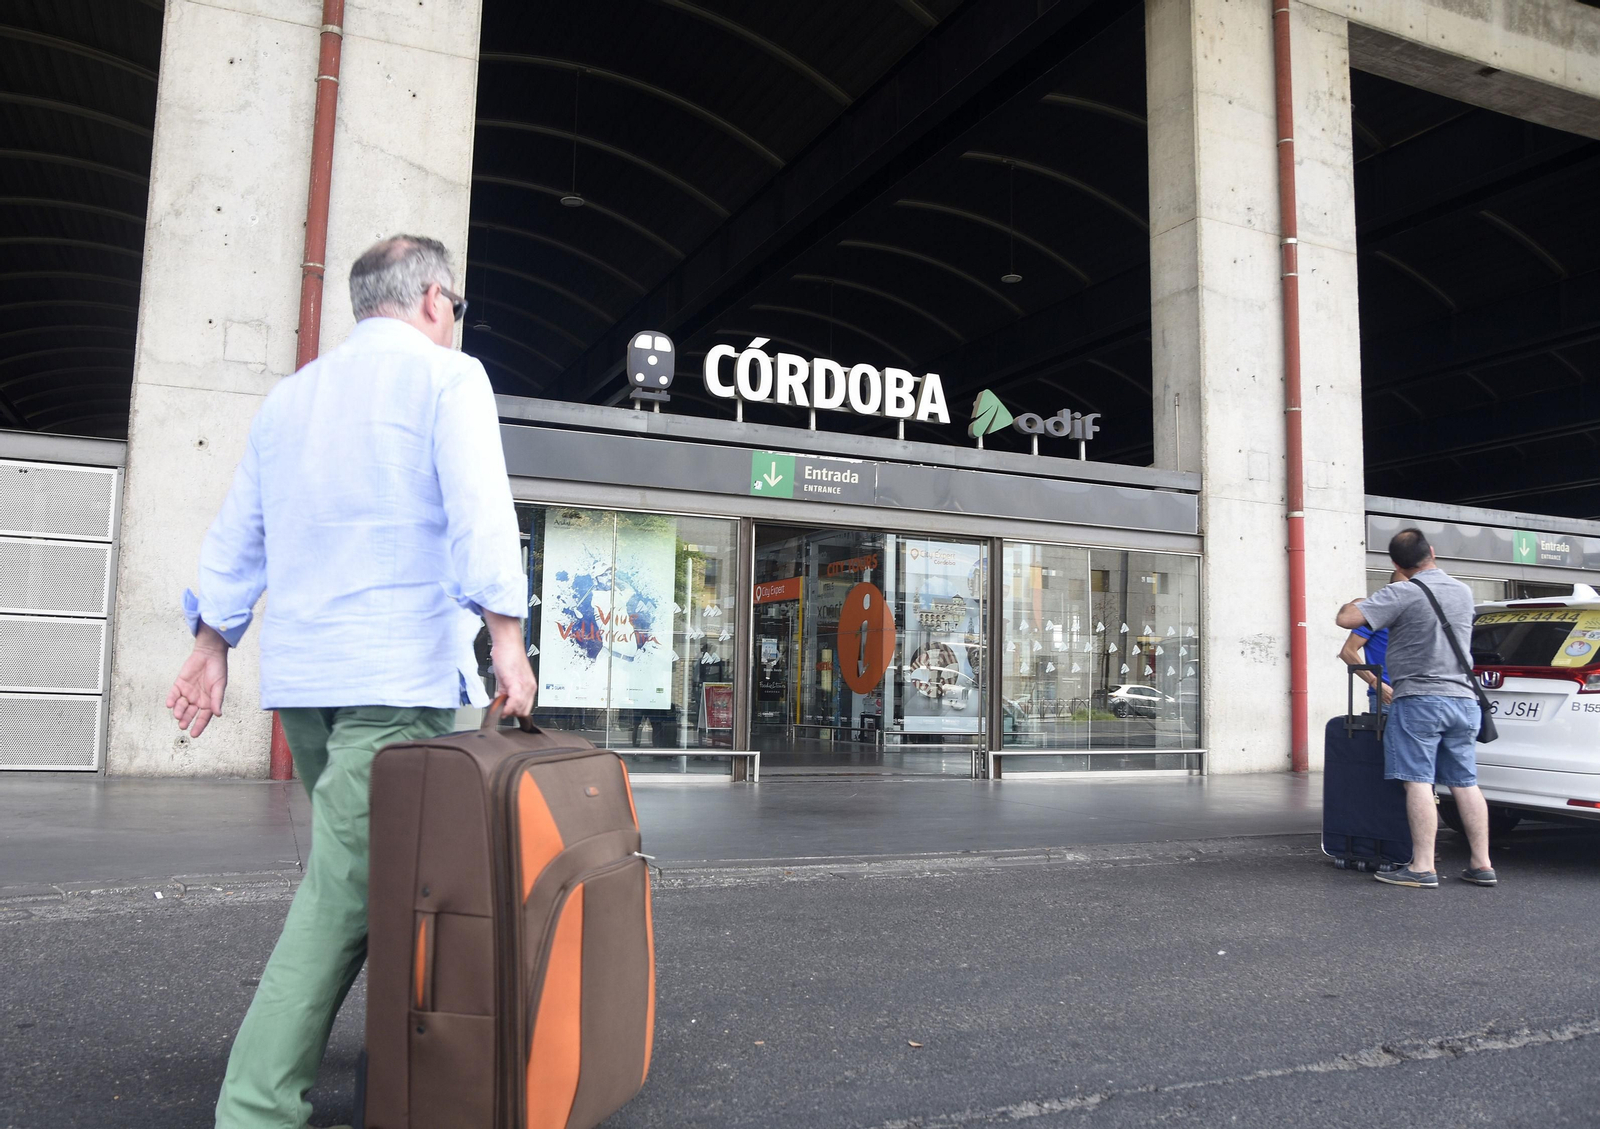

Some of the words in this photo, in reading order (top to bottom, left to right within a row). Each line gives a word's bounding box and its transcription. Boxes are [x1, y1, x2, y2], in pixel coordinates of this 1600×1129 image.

[703, 337, 951, 424] CÓRDOBA
[1012, 408, 1101, 440] adif
[804, 465, 859, 484] Entrada
[803, 484, 841, 495] ENTRANCE
[1541, 540, 1570, 553] Entrada
[920, 550, 933, 559] City
[1541, 553, 1562, 561] ENTRANCE
[827, 561, 845, 577] CITY
[846, 554, 878, 573] TOURS
[761, 586, 770, 597] City
[771, 585, 785, 595] Expert
[1478, 615, 1506, 625] 957
[1509, 613, 1529, 622] 76
[1531, 612, 1554, 621] 44
[1556, 612, 1580, 621] 44
[554, 620, 662, 645] Valderrama
[1504, 701, 1540, 718] JSH
[1571, 701, 1581, 711] B
